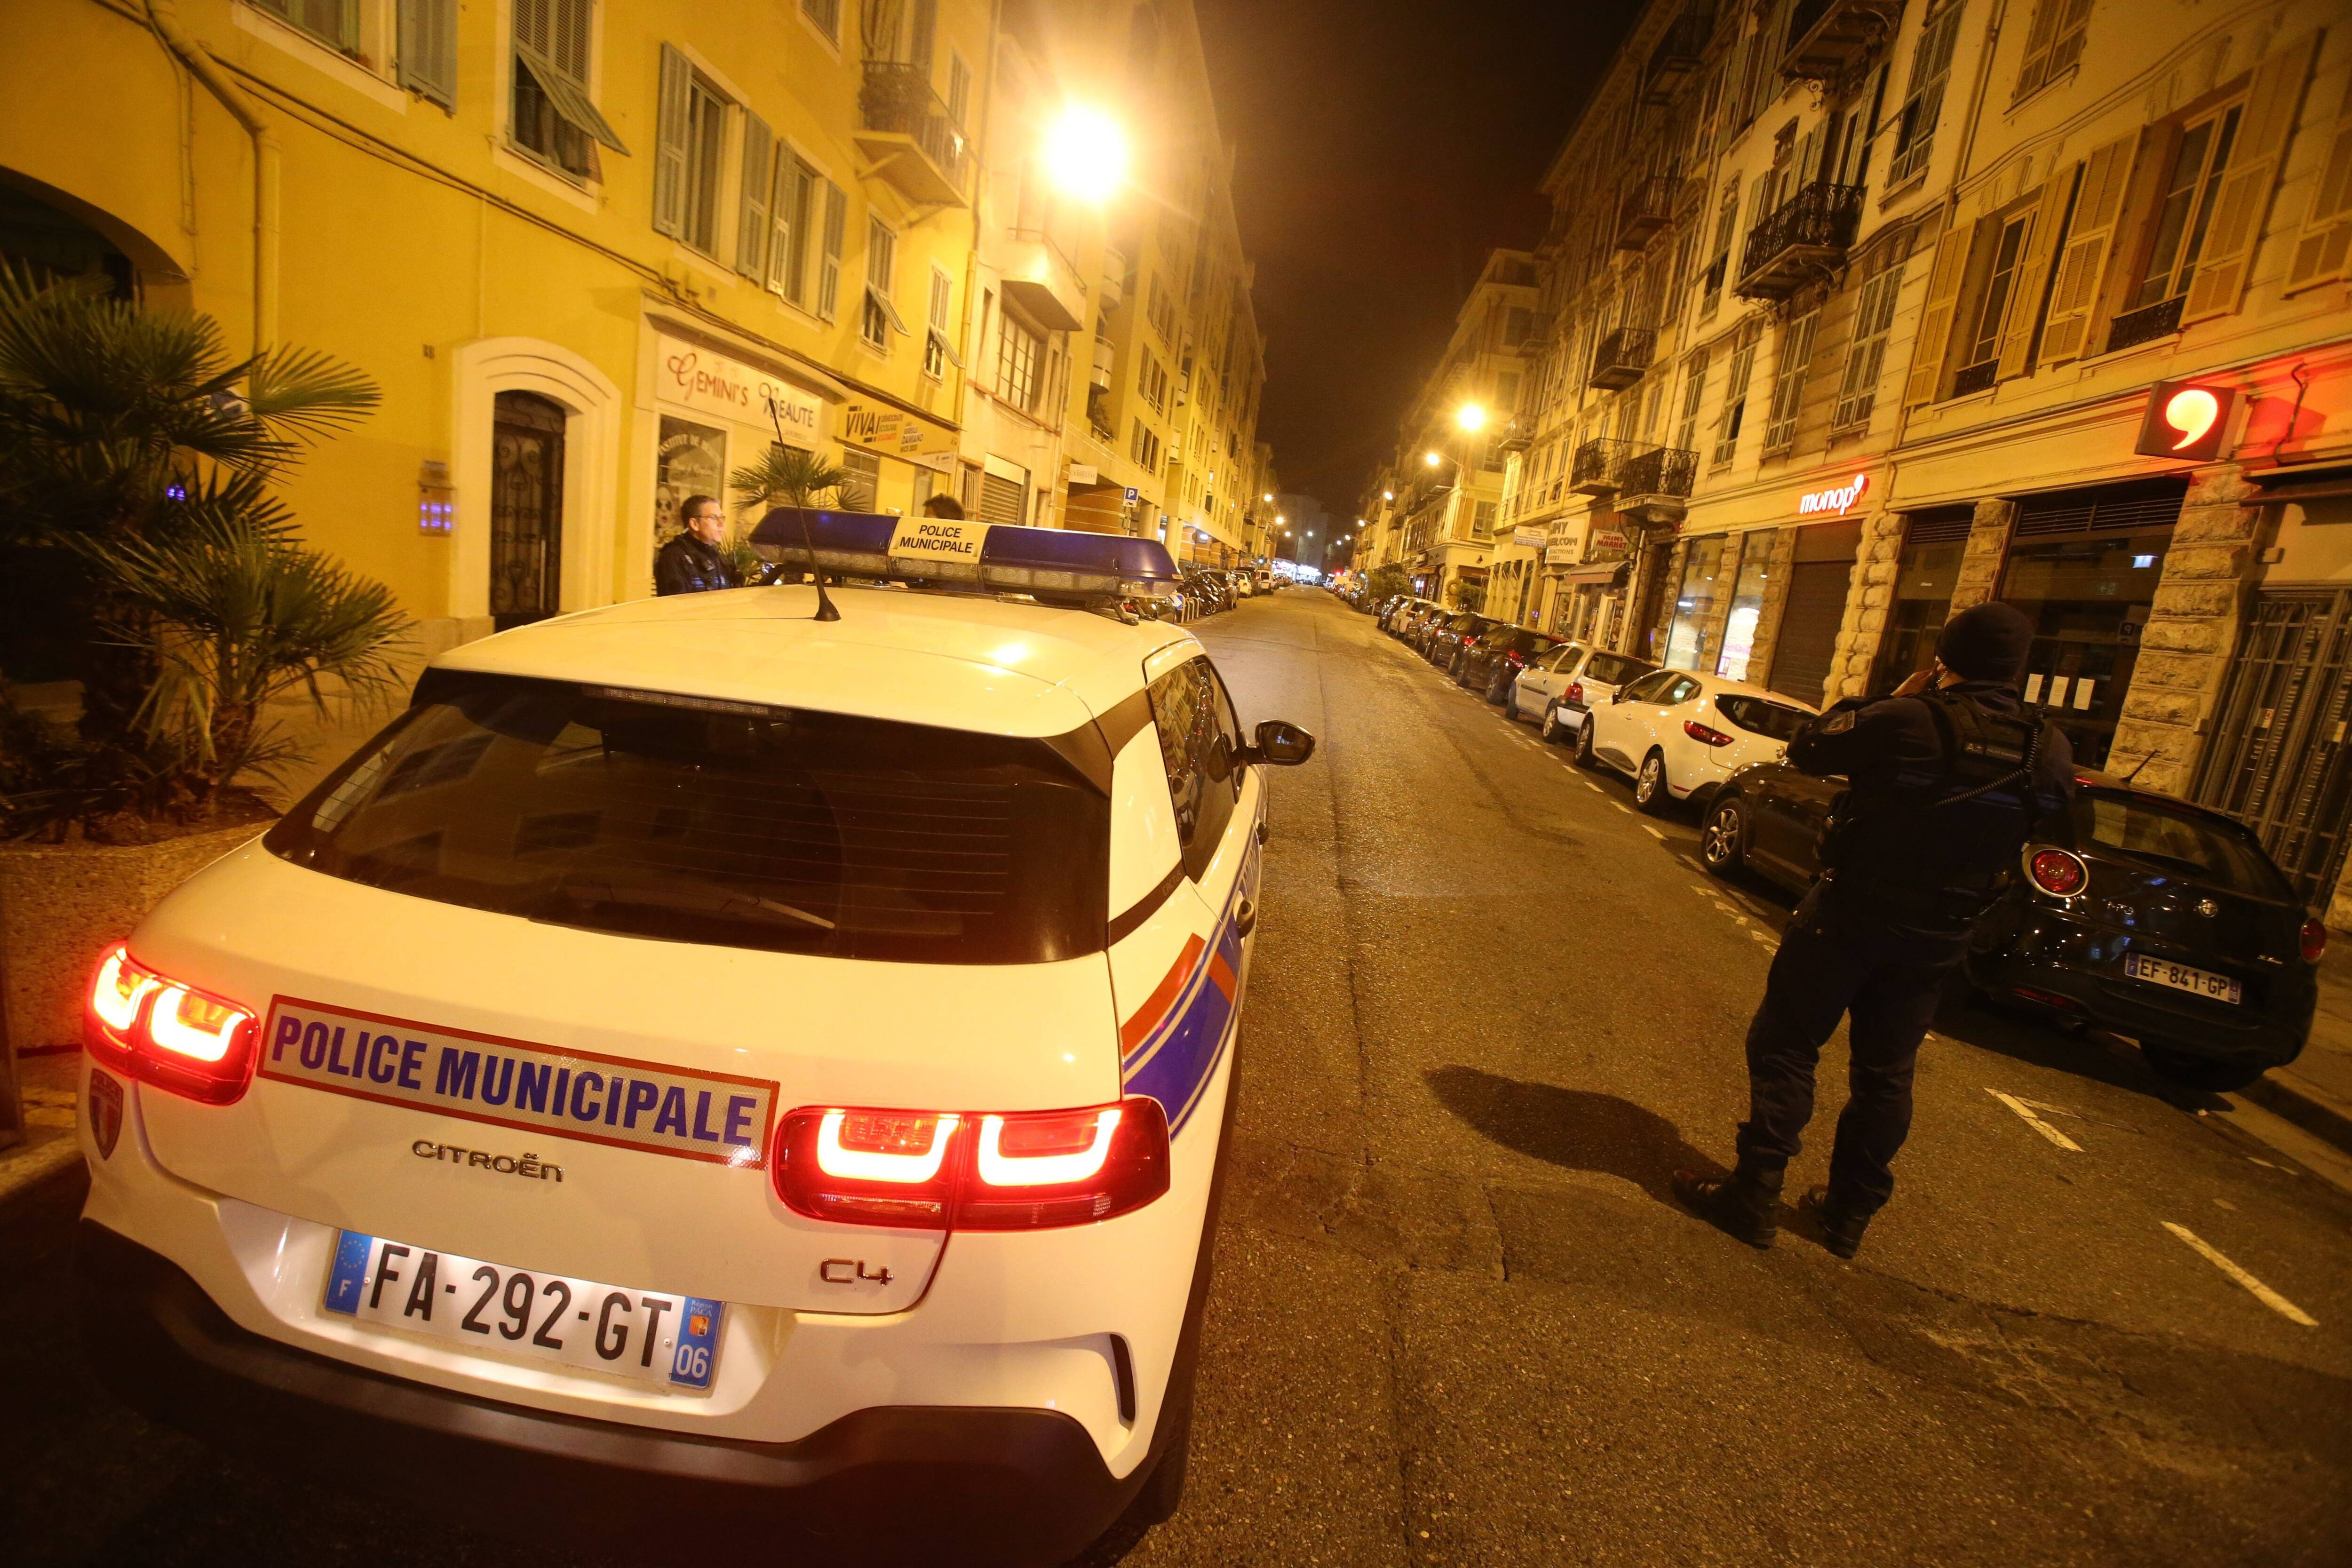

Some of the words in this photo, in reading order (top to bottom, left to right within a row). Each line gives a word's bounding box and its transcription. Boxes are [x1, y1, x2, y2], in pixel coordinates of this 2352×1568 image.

[1128, 489, 1135, 498] P
[919, 525, 962, 538] POLICE
[899, 536, 973, 553] MUNICIPALE
[1596, 540, 1627, 549] MARKET
[2139, 958, 2228, 997] EF-841-GP
[272, 1015, 427, 1090] POLICE
[435, 1047, 756, 1146] MUNICIPALE
[820, 1258, 894, 1286] C4
[339, 1279, 352, 1297] F
[369, 1243, 672, 1368] FA-292-GT
[691, 1306, 712, 1317] PACA
[676, 1344, 709, 1378] 06
